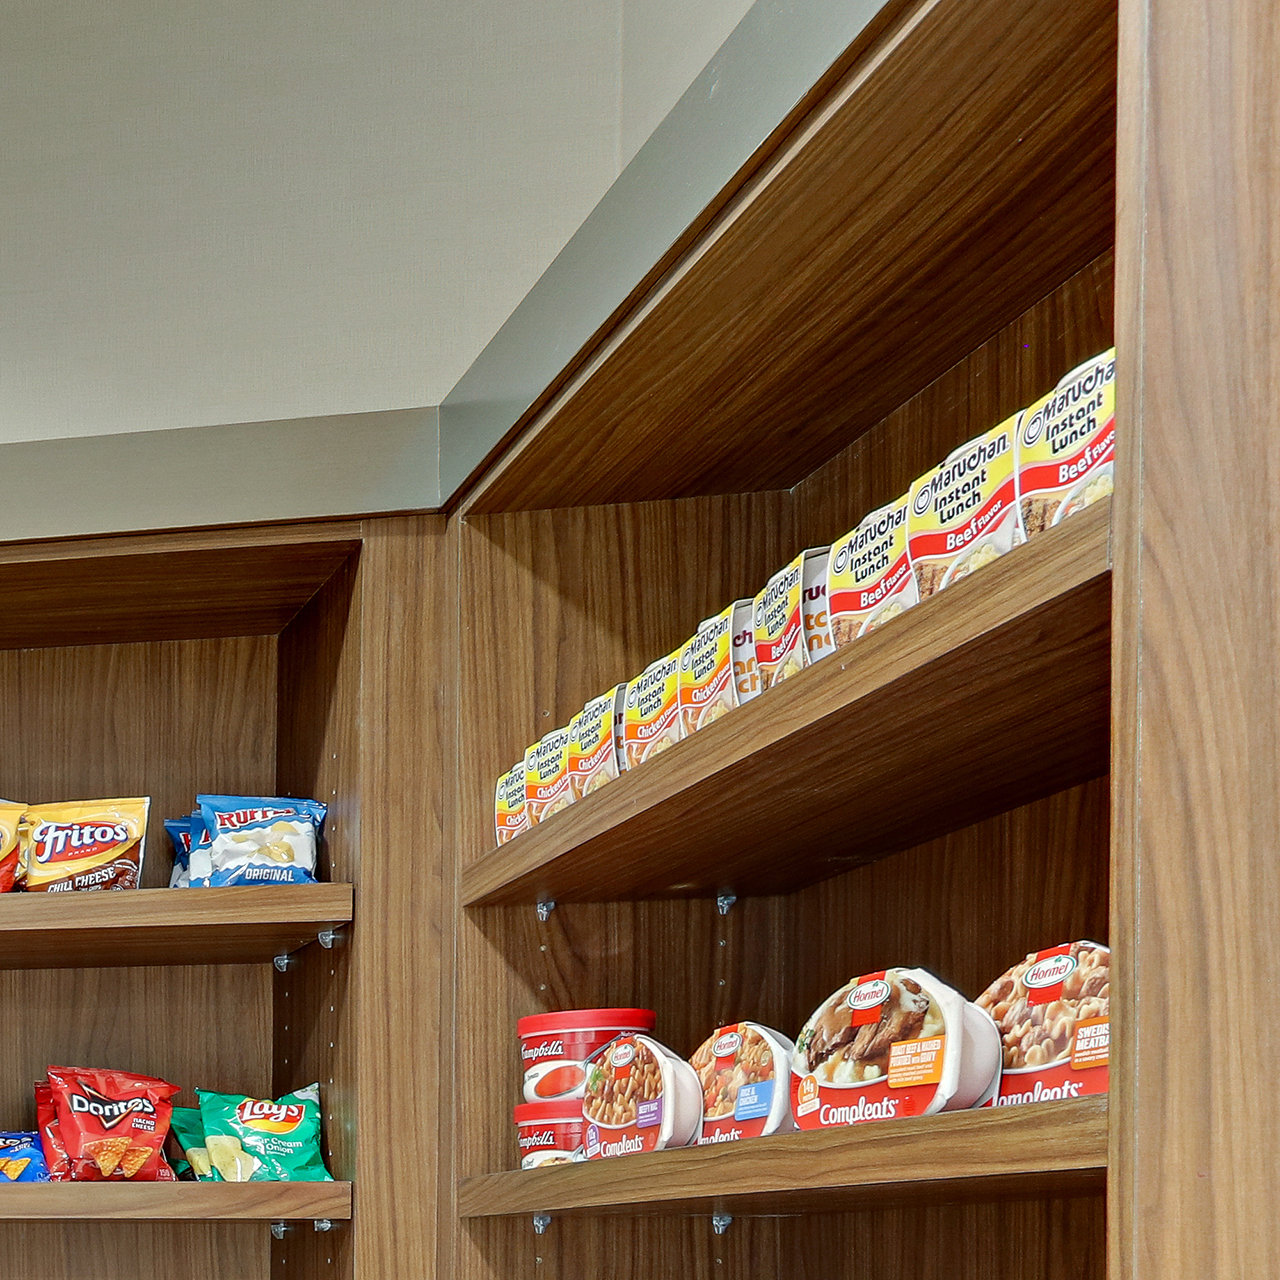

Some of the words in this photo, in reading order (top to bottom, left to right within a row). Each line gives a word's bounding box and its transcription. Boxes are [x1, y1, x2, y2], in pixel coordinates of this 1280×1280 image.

[1045, 392, 1103, 441] Instant
[1051, 416, 1096, 454] Lunch
[930, 433, 1008, 494] Maruchan
[1058, 447, 1094, 483] Beef
[934, 469, 987, 512] Instant
[939, 490, 982, 525] Lunch
[946, 516, 979, 551] Beef
[977, 499, 1002, 530] Flavor
[850, 533, 894, 571] Instant
[854, 552, 889, 583] Lunch
[763, 566, 800, 607] Maruchan
[860, 581, 887, 608] Beef
[886, 563, 907, 591] Flavor
[763, 594, 789, 626] Instant
[690, 616, 729, 655] Maruchan
[767, 612, 787, 637] Lunch
[691, 641, 718, 671] Instant
[771, 637, 786, 659] Beef
[636, 657, 677, 692] Maruchan
[694, 659, 715, 681] Lunch
[637, 683, 665, 709] Instant
[692, 678, 719, 702] Chicken
[578, 696, 612, 728] Maruchan
[640, 697, 662, 718] Lunch
[578, 719, 602, 741] Instant
[637, 714, 665, 738] Chicken
[580, 733, 600, 751] Lunch
[537, 751, 563, 772] Instant
[539, 762, 560, 780] Lunch
[578, 750, 603, 771] Chicken
[537, 777, 562, 799] Chicken
[33, 819, 128, 864] Fritos
[76, 867, 117, 887] CHEESE
[245, 867, 295, 882] ORIGINAL
[1030, 963, 1070, 982] Hormel
[853, 988, 887, 1003] Hormel
[521, 1040, 564, 1060] Campbell's
[716, 1039, 738, 1052] Hormel
[614, 1052, 632, 1062] Hormel
[72, 1095, 155, 1116] Doritos
[241, 1100, 301, 1121] Lay's
[820, 1097, 897, 1126] Compleats
[131, 1123, 157, 1132] CHEESE
[132, 1118, 156, 1126] NACHO
[266, 1144, 294, 1154] Onion
[275, 1138, 303, 1147] Cream
[600, 1134, 644, 1156] Compleats
